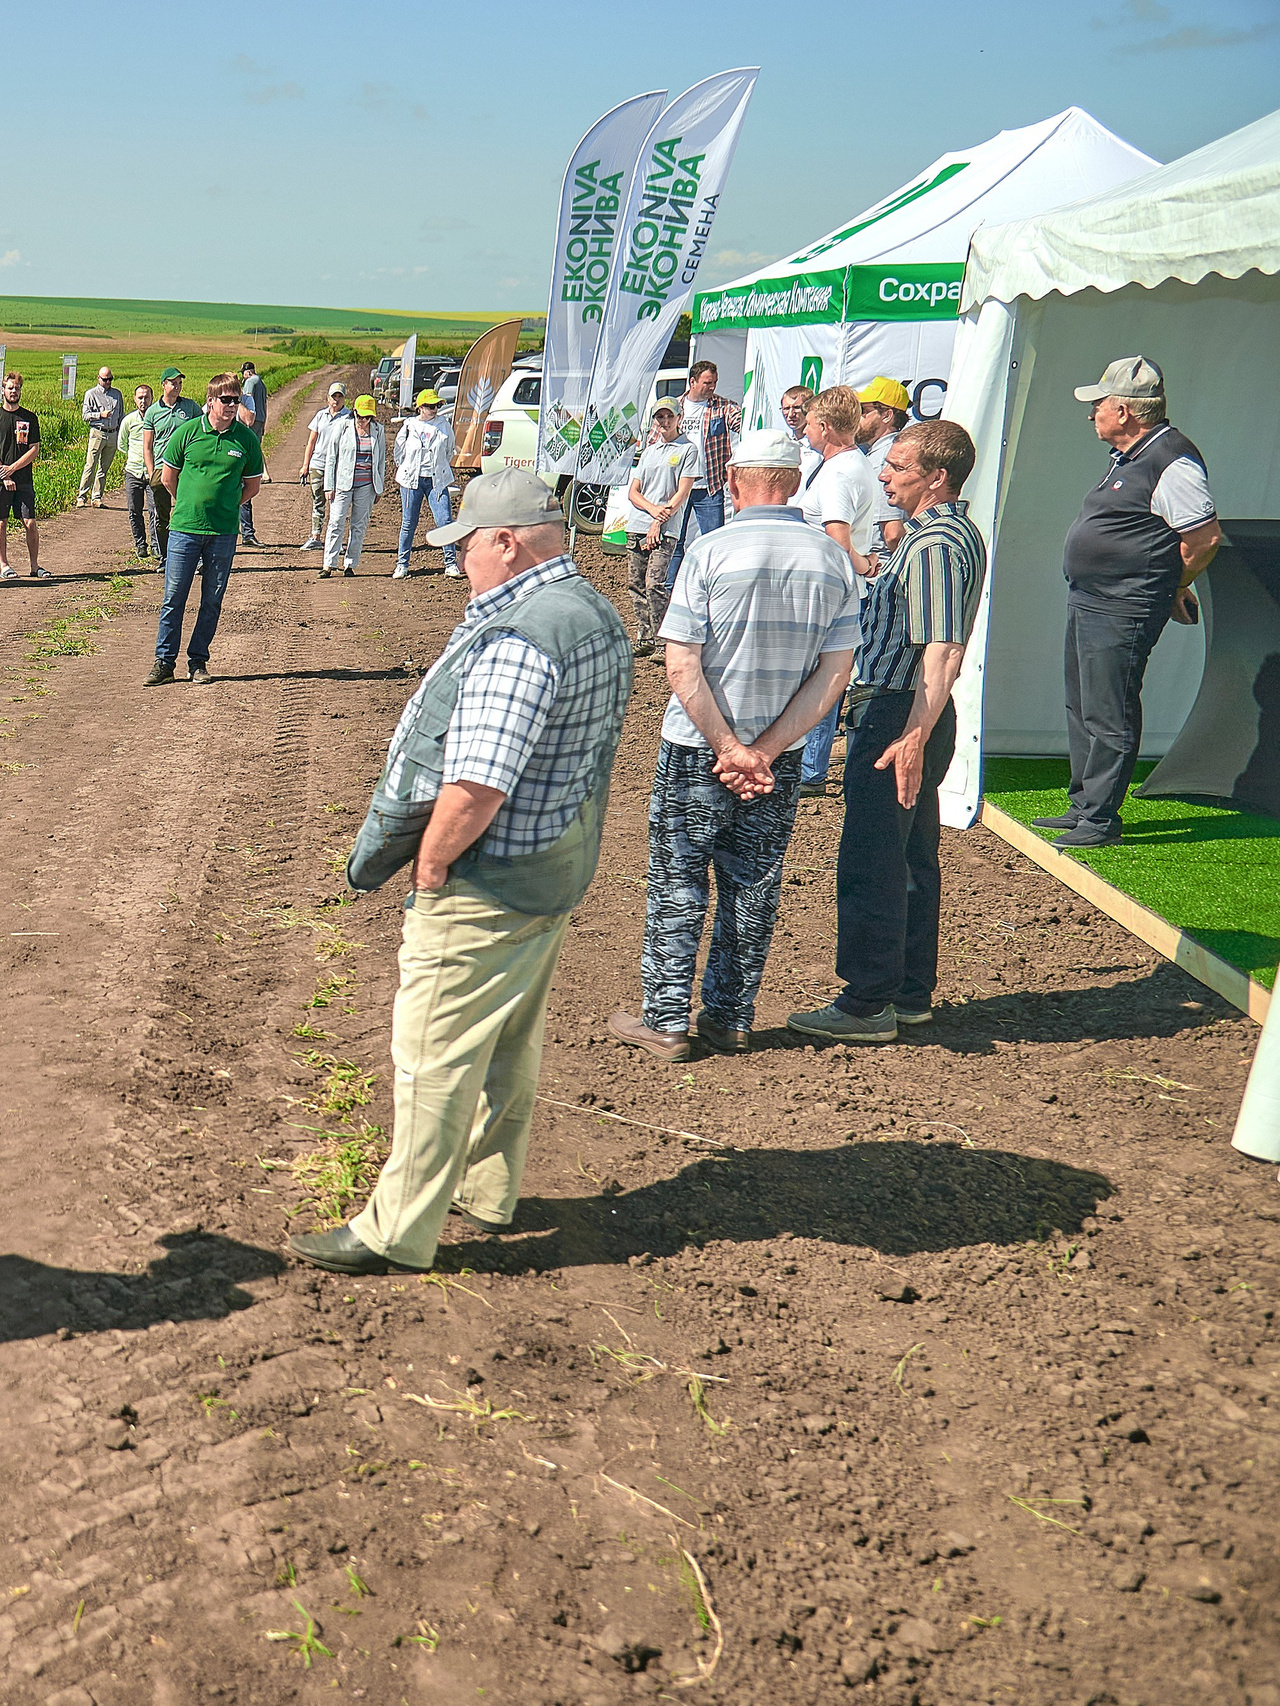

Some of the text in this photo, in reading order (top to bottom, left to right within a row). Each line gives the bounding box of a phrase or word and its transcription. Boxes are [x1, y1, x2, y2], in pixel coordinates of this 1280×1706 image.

[561, 159, 601, 303] EKONIVA
[582, 170, 625, 325] ЭКОНИВА
[620, 136, 683, 296] EKONIVA
[636, 153, 707, 323] ЭКОНИВА
[681, 193, 720, 285] СЕМЕНА
